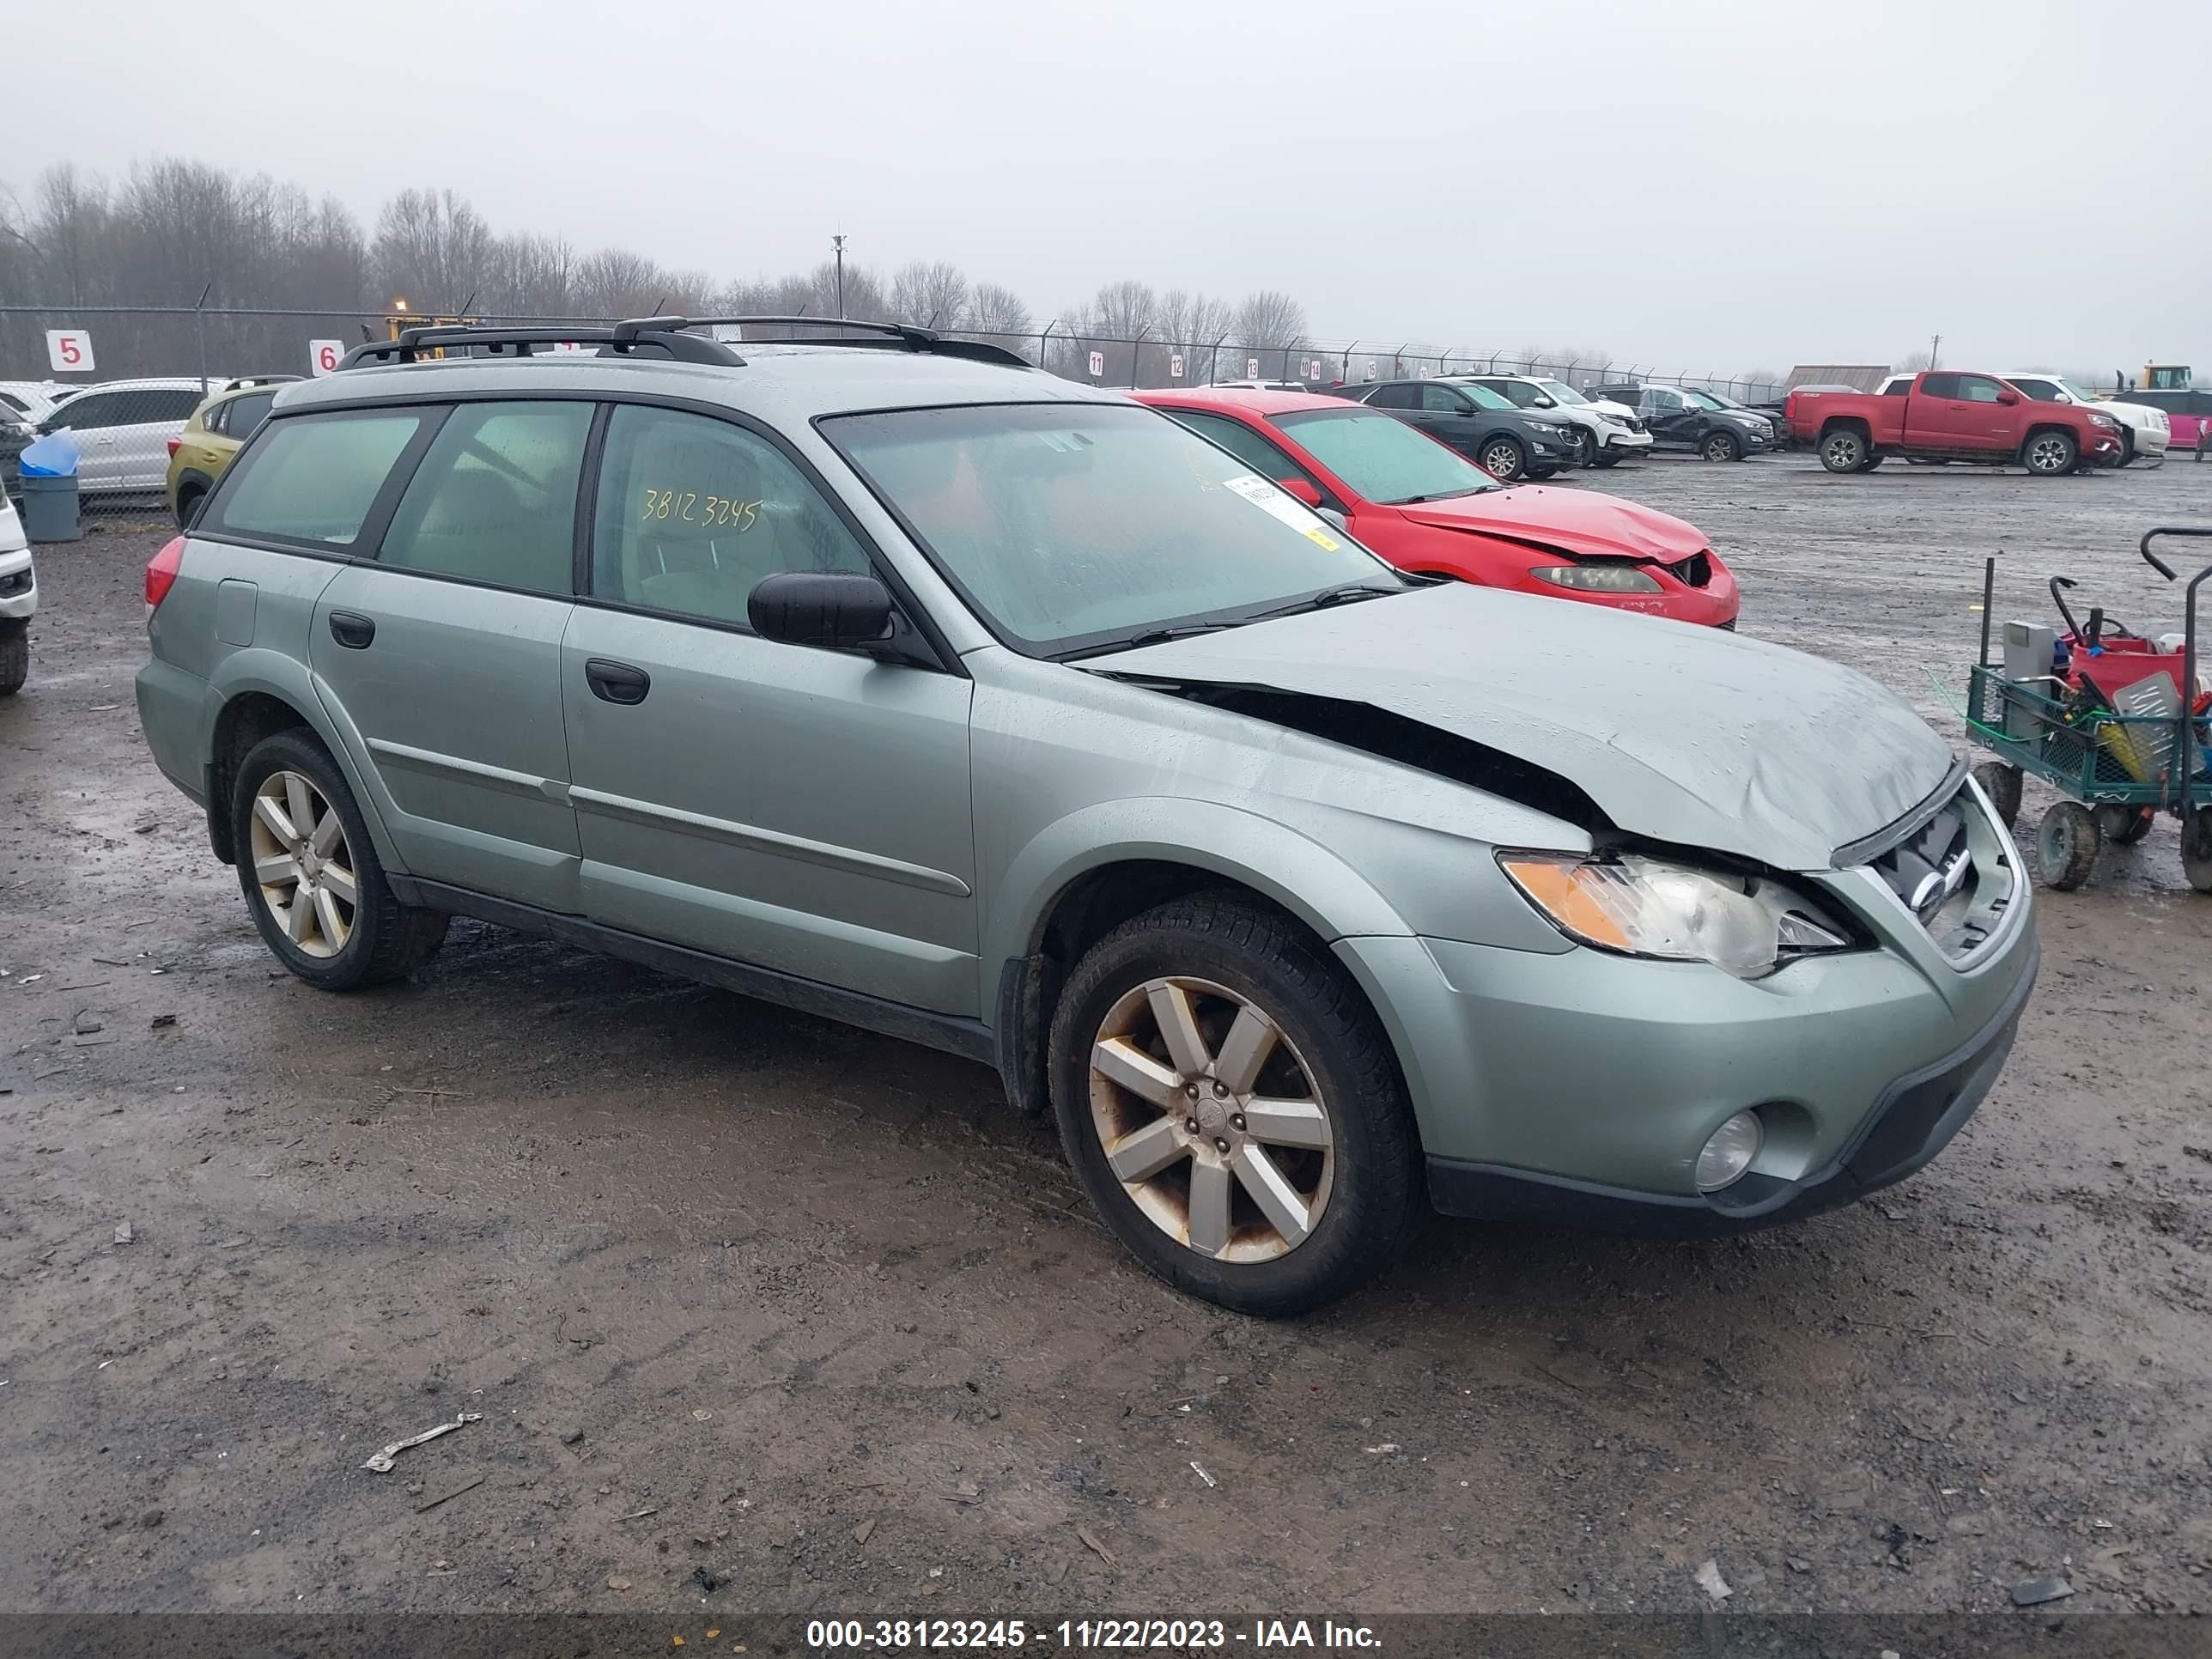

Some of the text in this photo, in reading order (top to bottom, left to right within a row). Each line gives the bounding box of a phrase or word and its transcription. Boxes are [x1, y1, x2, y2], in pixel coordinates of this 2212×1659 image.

[60, 337, 81, 364] 5
[320, 346, 337, 370] 6
[1091, 356, 1102, 373] 11
[1173, 359, 1182, 374] 12
[1249, 362, 1257, 376] 13
[1312, 364, 1320, 377] 14
